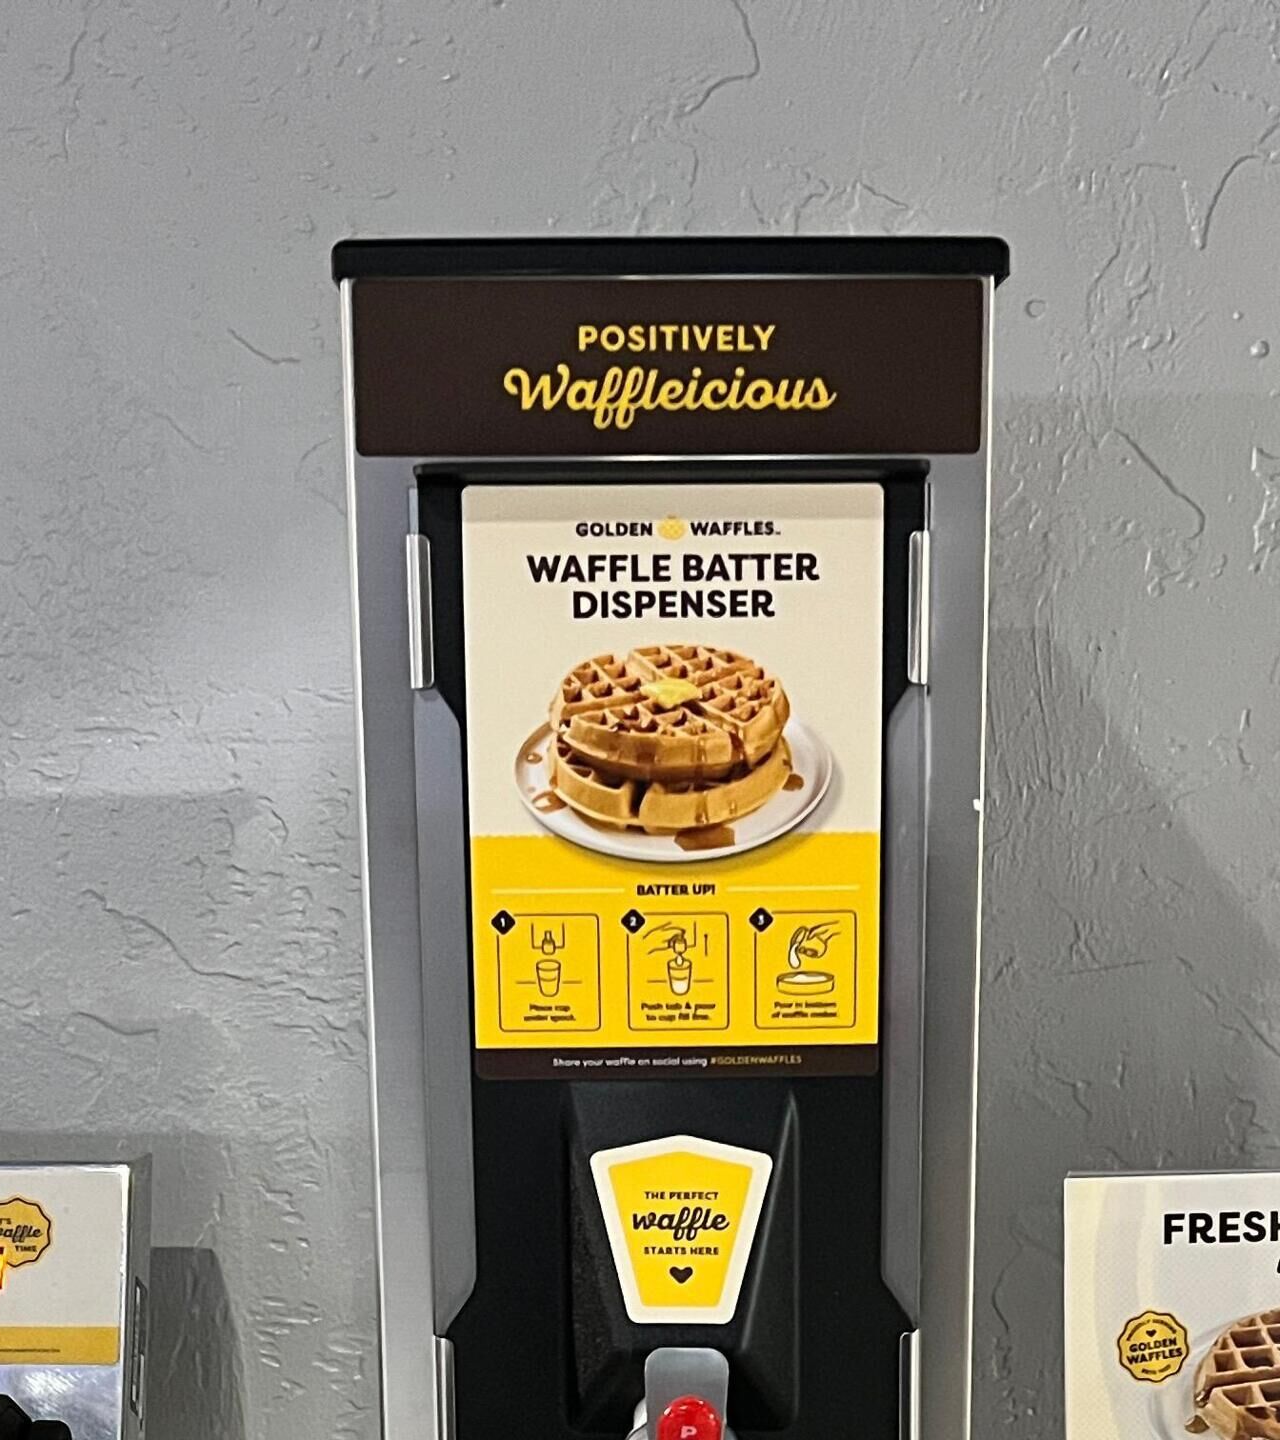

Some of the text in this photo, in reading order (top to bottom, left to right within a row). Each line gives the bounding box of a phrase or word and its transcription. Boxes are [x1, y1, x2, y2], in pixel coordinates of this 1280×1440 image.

[577, 324, 776, 352] POSITIVELY
[503, 364, 837, 430] Waffleicious
[575, 522, 653, 537] GOLDEN
[526, 553, 820, 583] WAFFLE BATTER
[572, 589, 776, 619] DISPENSER
[636, 884, 716, 896] BATTER UP!
[500, 916, 506, 928] 1
[629, 916, 638, 928] 2
[757, 914, 766, 926] 3
[605, 1057, 636, 1066] waffle
[682, 1057, 708, 1067] using
[644, 1191, 719, 1200] THE PERFECT
[632, 1206, 730, 1241] waffle
[643, 1246, 720, 1255] STARTS HERE
[1129, 1337, 1177, 1352] GOLDEN
[1126, 1347, 1183, 1365] WAFFLES
